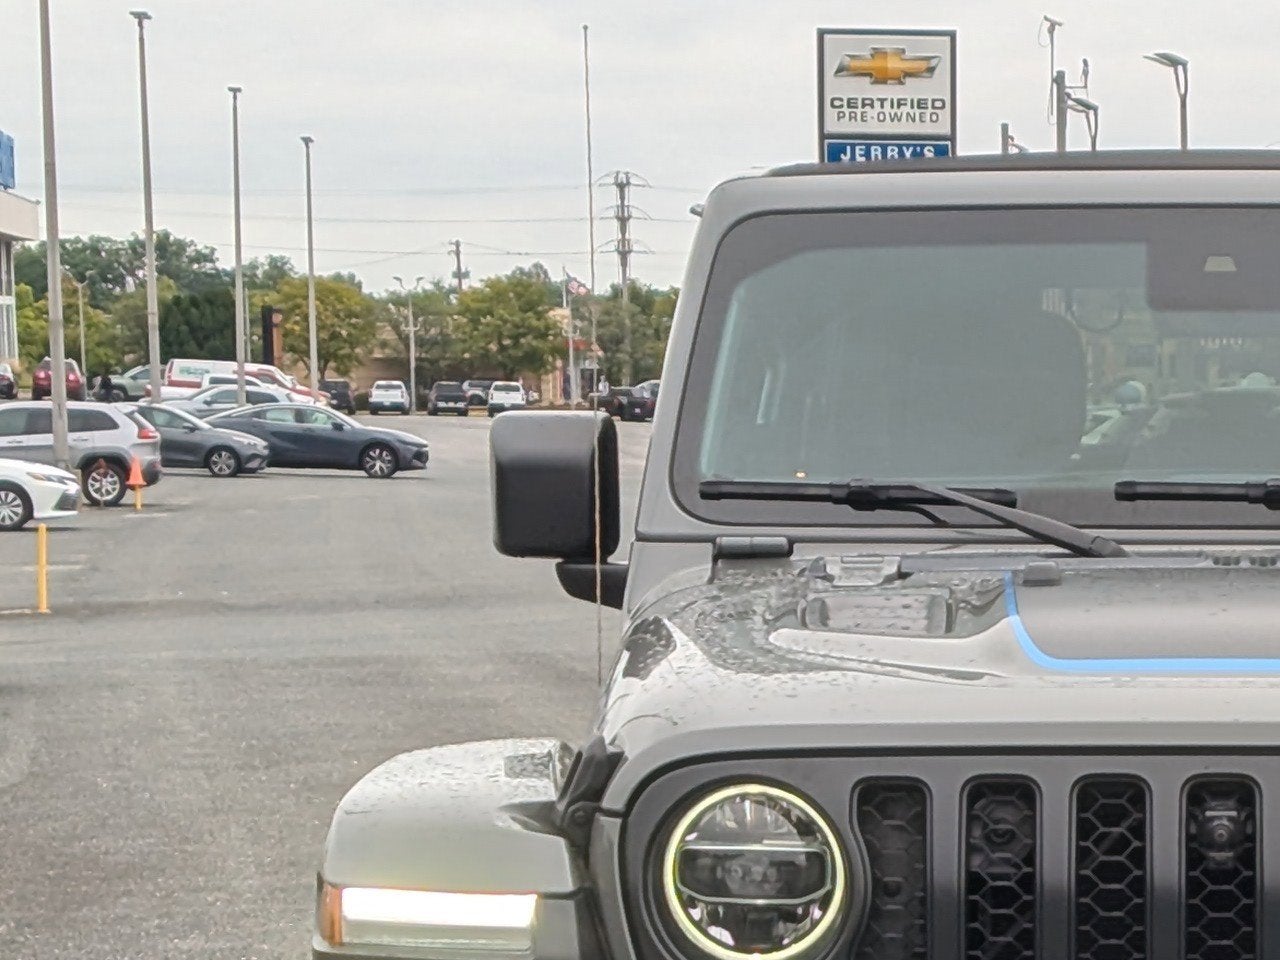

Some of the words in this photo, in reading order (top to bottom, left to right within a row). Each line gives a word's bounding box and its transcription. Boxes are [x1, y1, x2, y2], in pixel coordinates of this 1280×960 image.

[829, 97, 946, 111] CERTIFIED
[836, 111, 940, 124] PRE-OWNED
[840, 145, 935, 162] JERRY'S
